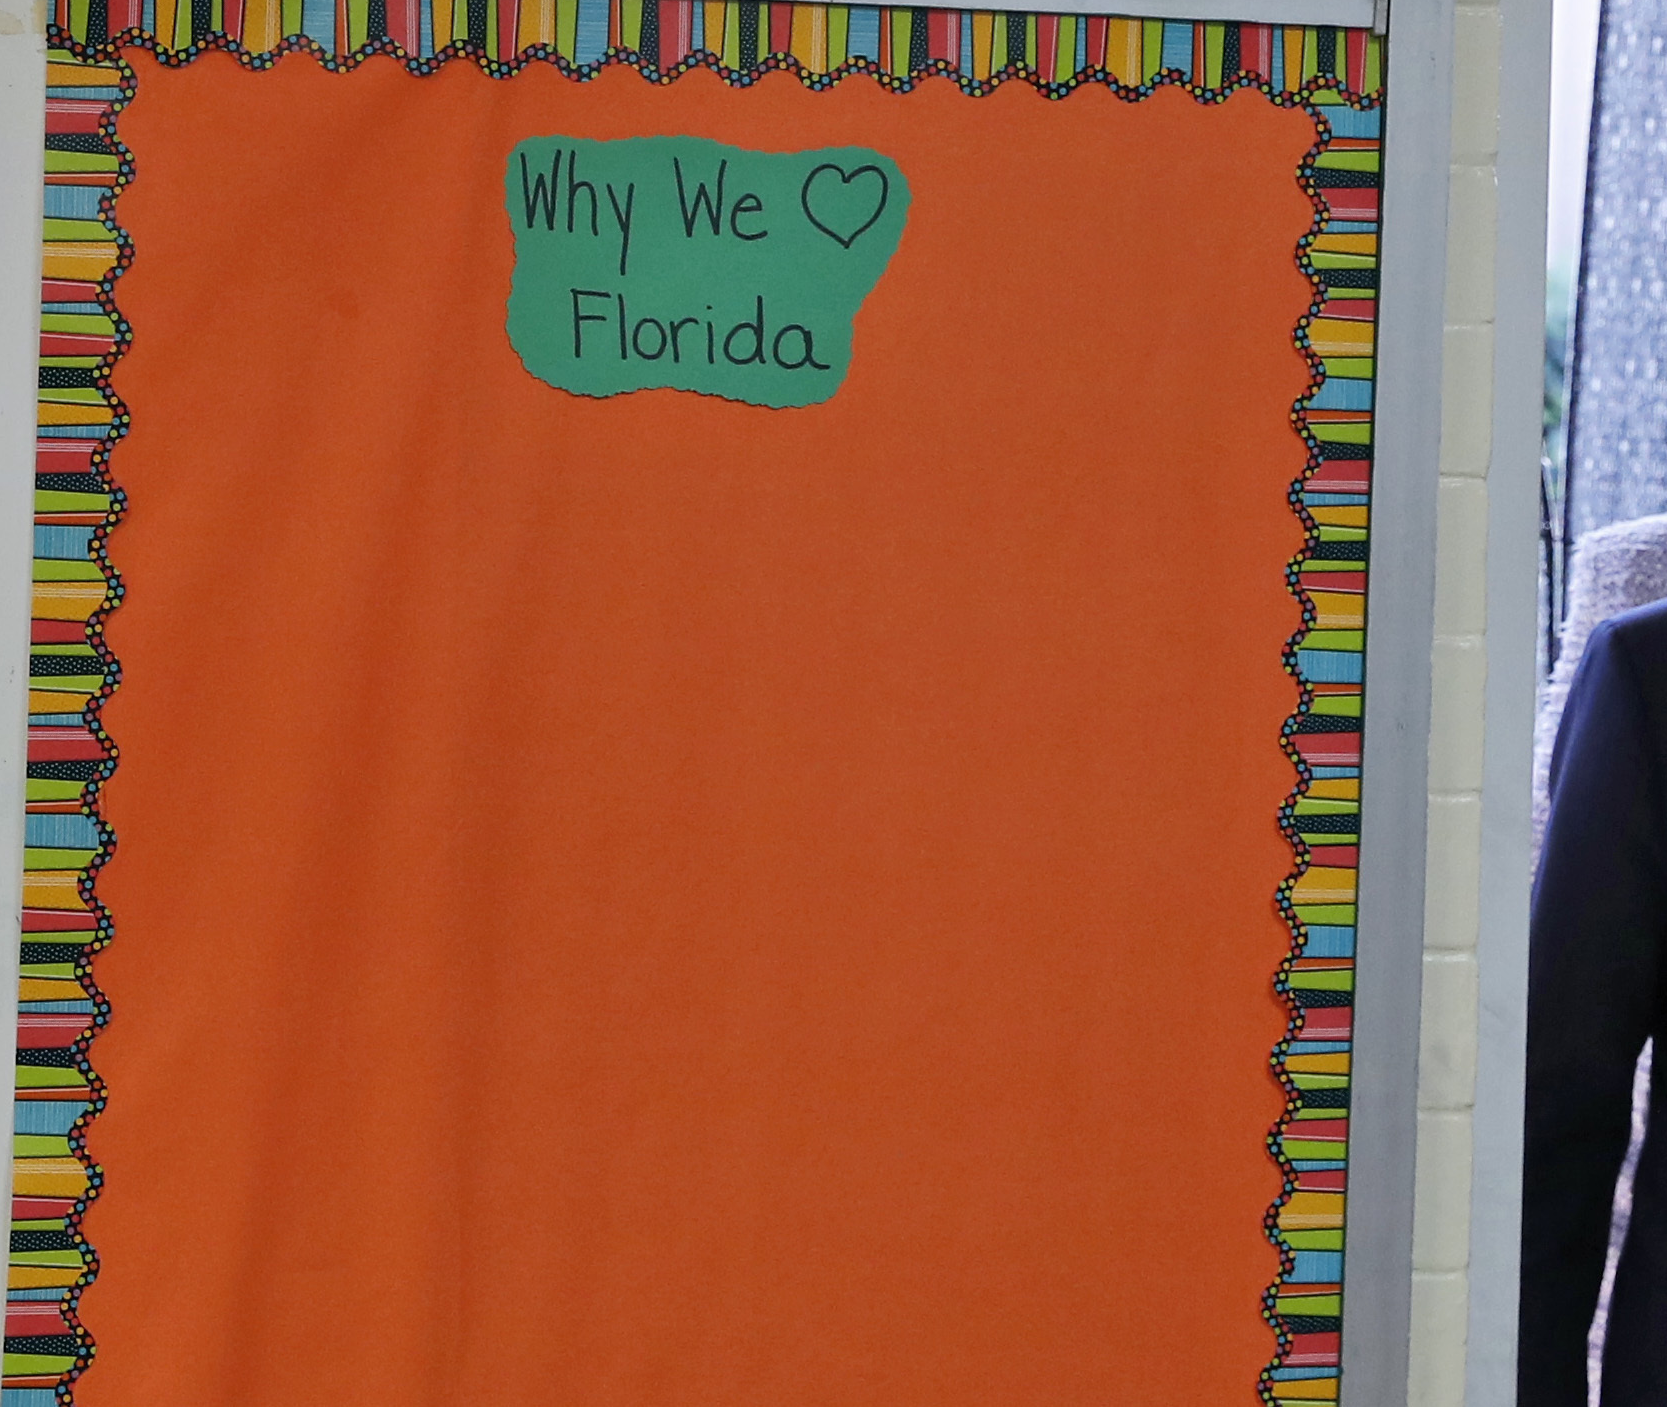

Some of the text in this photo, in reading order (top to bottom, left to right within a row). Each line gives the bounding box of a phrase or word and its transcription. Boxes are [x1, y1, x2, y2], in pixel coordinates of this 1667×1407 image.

[518, 147, 770, 278] Why We
[568, 287, 833, 372] Florida
